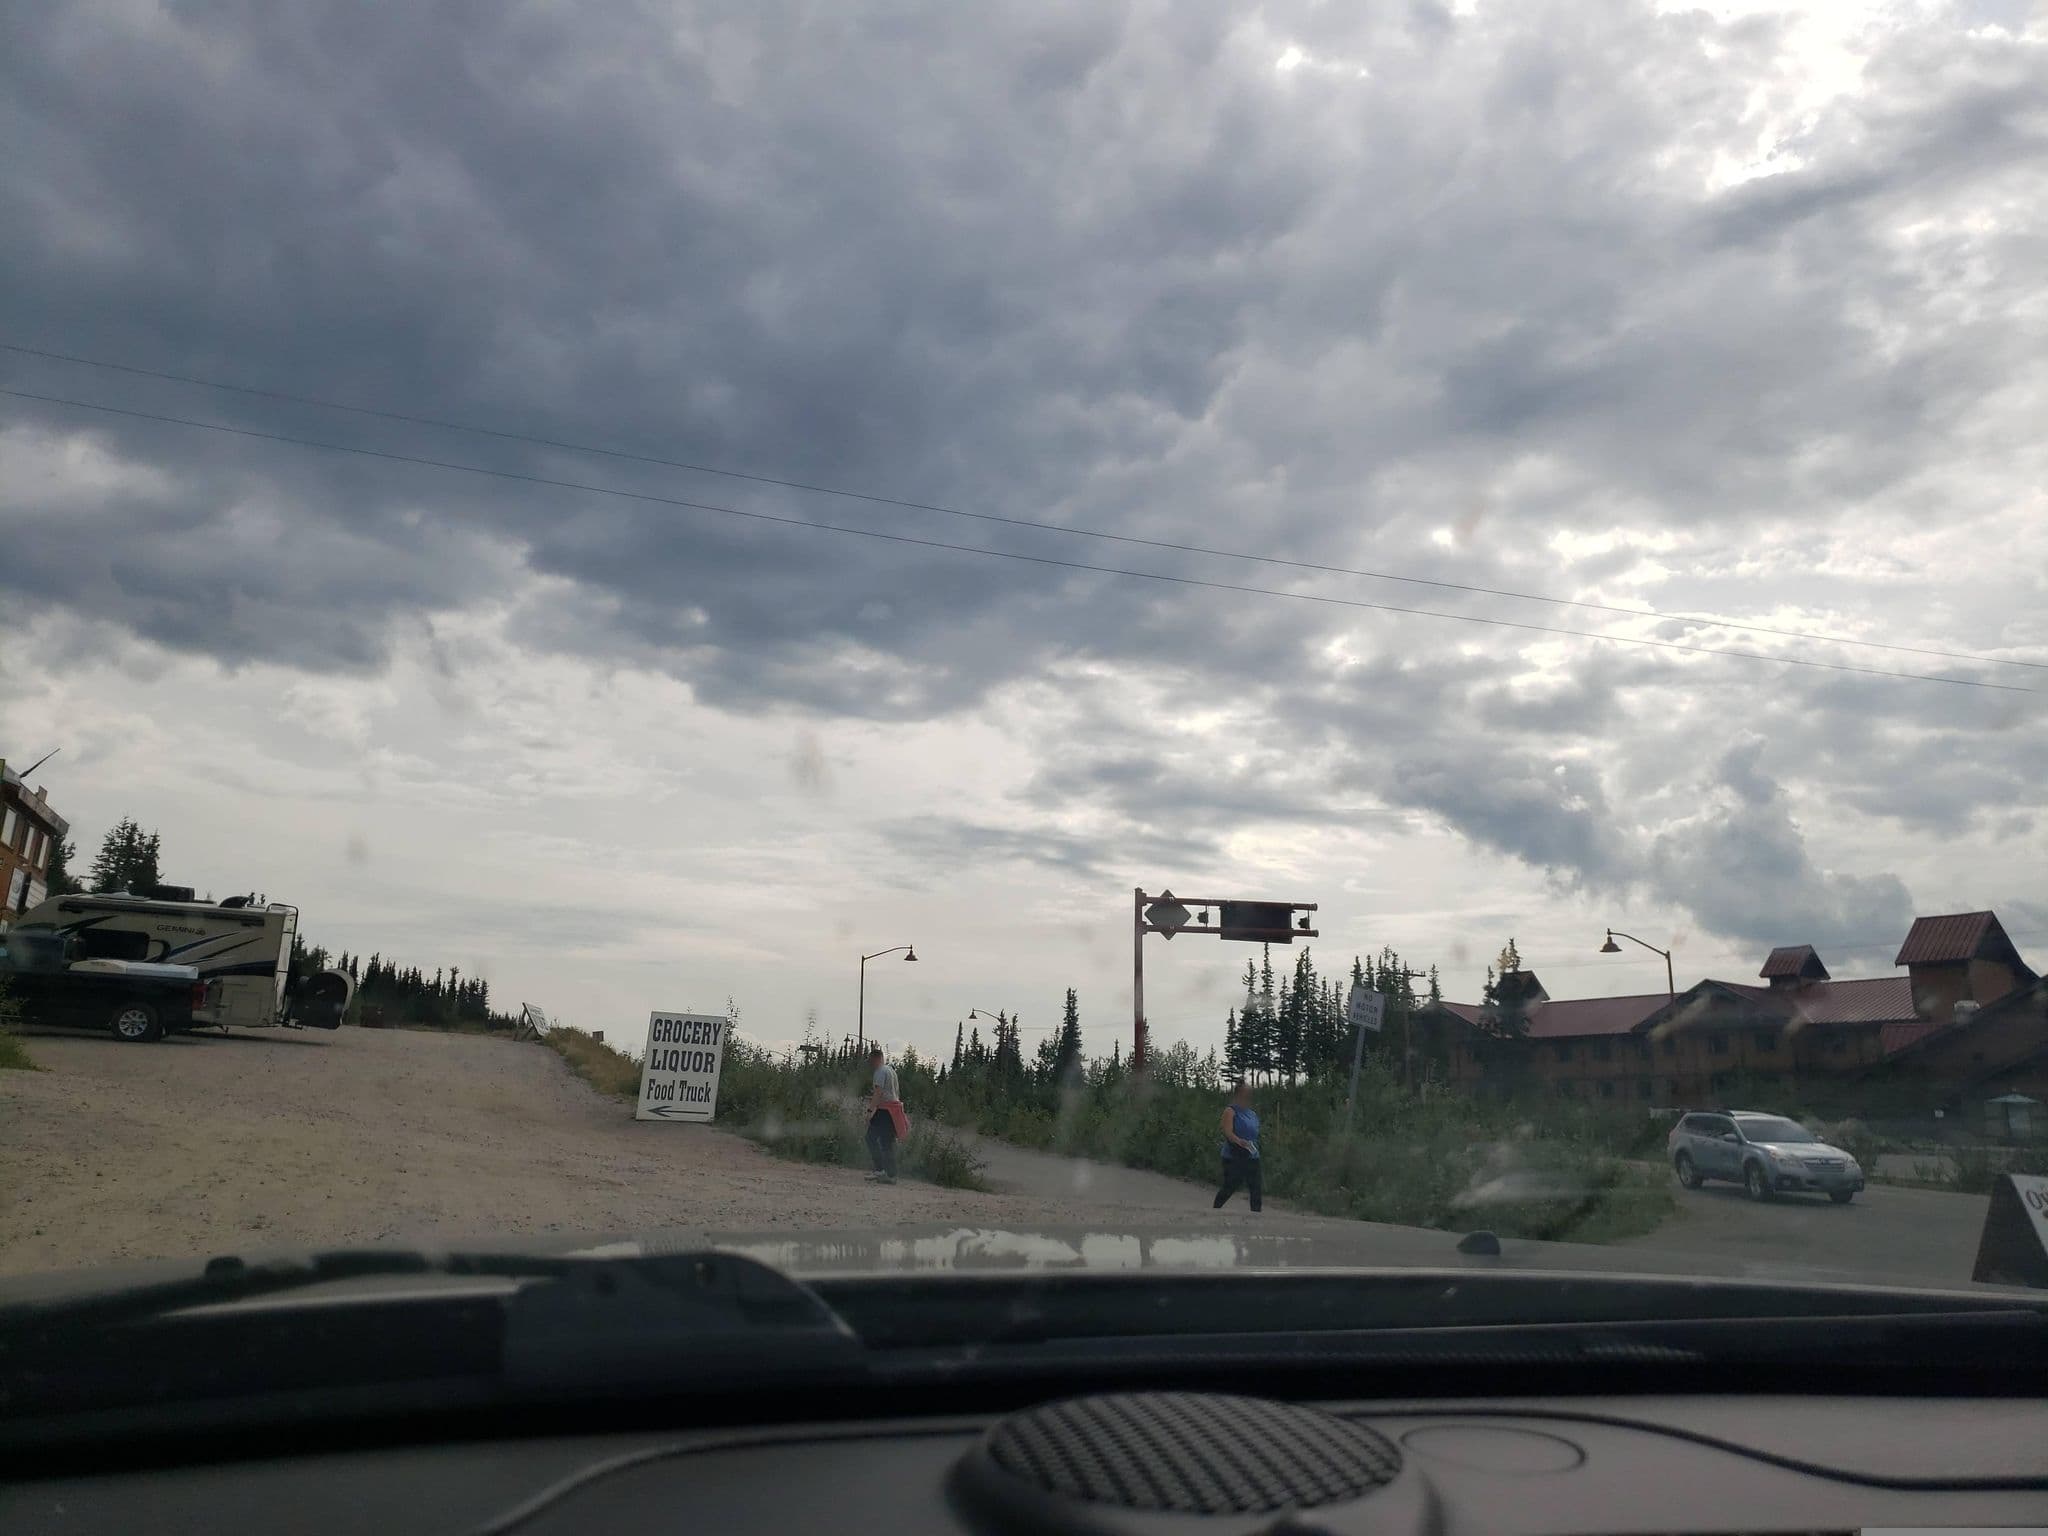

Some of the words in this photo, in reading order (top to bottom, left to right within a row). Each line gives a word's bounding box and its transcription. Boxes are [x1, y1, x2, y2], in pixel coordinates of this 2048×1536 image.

[652, 1018, 722, 1046] GROCERY
[650, 1048, 715, 1074] LIQUOR
[646, 1078, 675, 1101] Food
[679, 1080, 711, 1103] Truck
